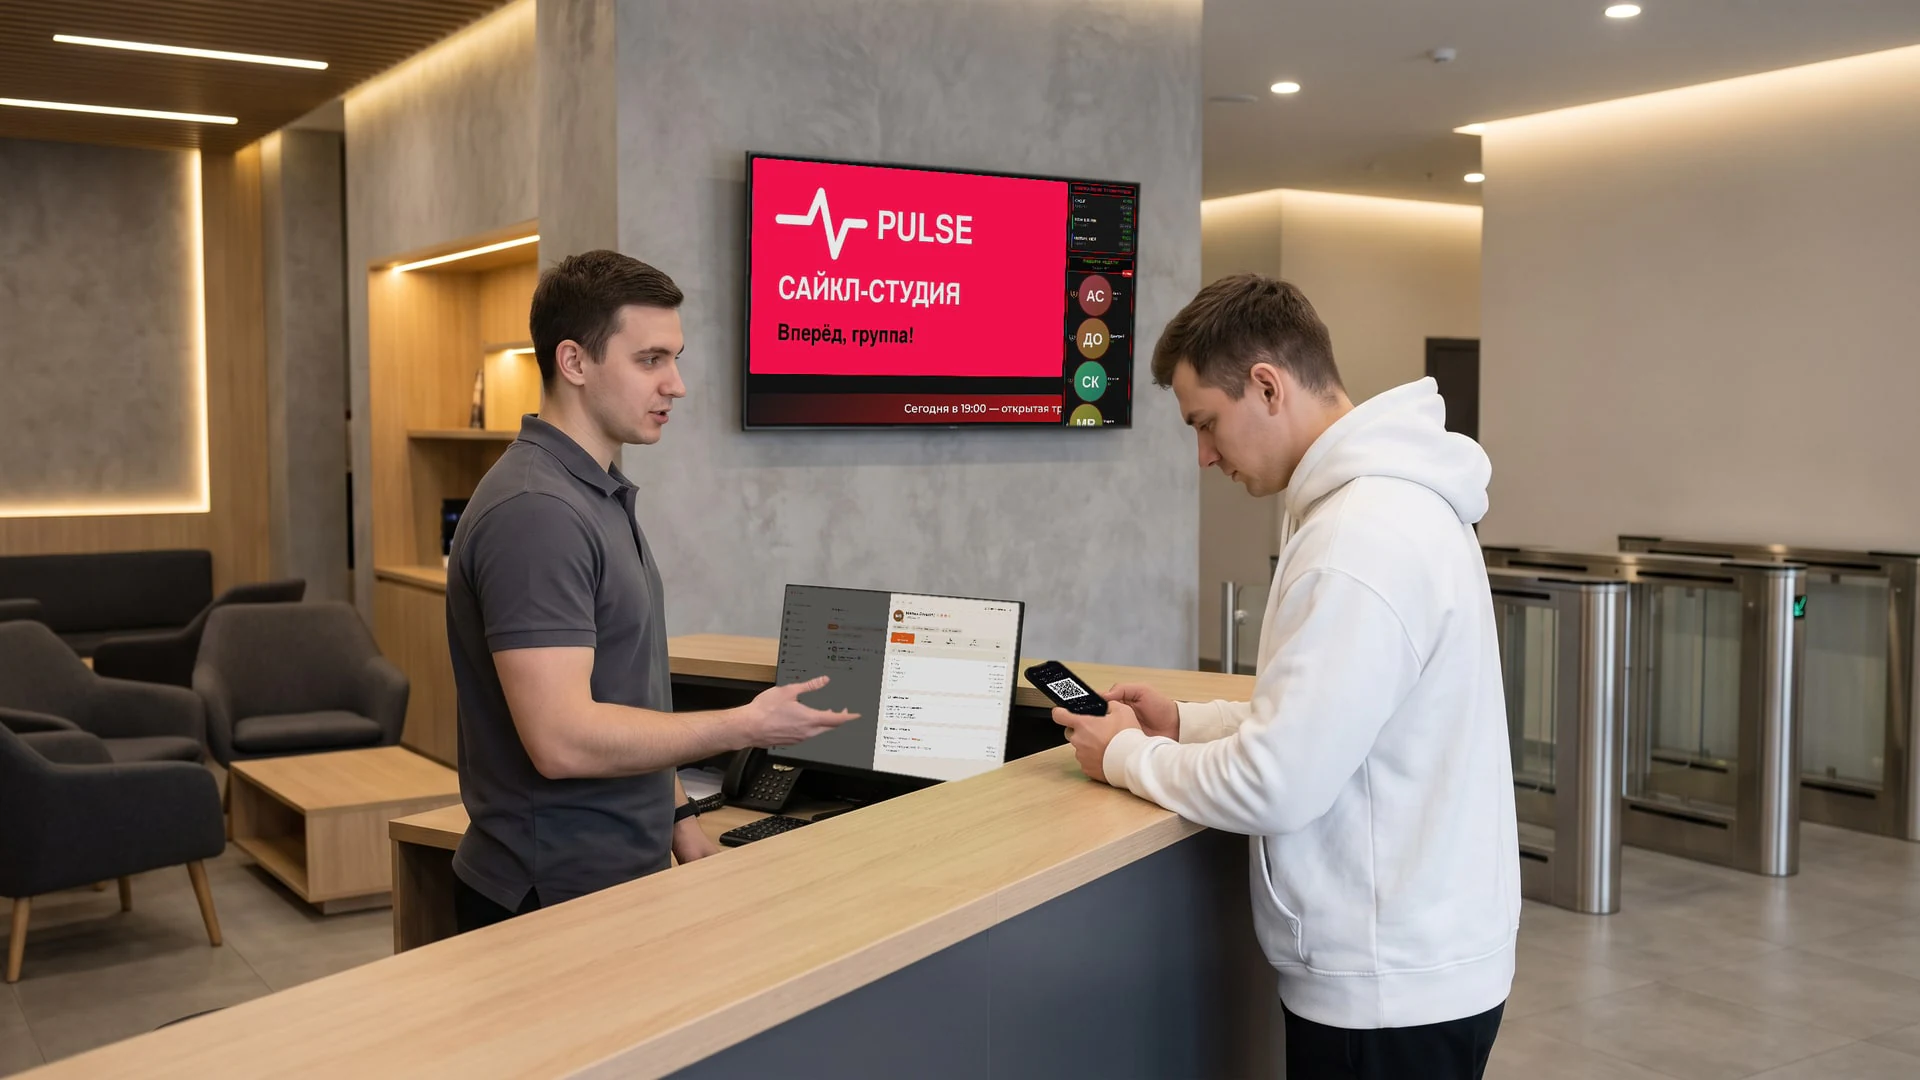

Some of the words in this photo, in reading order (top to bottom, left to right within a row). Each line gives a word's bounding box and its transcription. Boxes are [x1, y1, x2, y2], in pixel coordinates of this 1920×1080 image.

[877, 209, 973, 245] PULSE
[778, 270, 961, 308] САЙКЛ-СТУДИЯ
[1086, 290, 1105, 303] АС
[778, 322, 847, 347] Вперёд,
[851, 326, 914, 348] группа!
[1082, 332, 1103, 348] ДО
[1082, 375, 1100, 389] СК
[904, 403, 950, 416] Сегодня
[951, 405, 959, 414] в
[960, 403, 987, 414] 19:00
[1001, 405, 1049, 416] открытая
